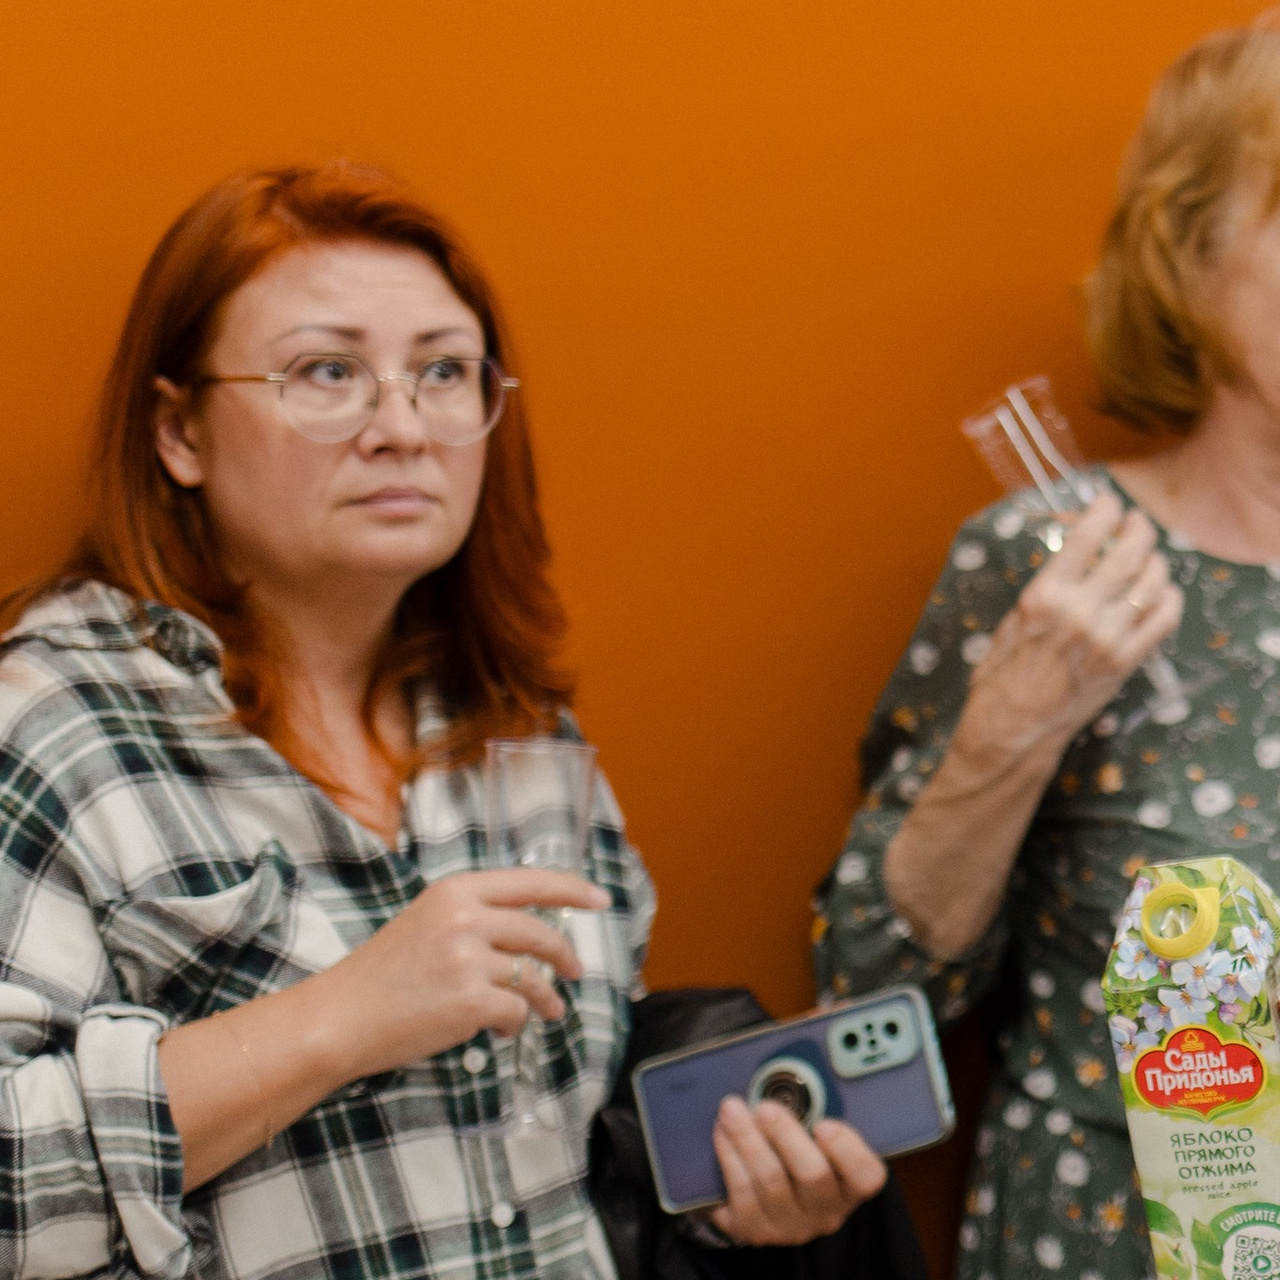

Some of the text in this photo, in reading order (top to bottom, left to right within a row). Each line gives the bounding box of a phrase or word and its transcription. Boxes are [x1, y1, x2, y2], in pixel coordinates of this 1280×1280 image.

[1164, 1049, 1227, 1072] Сады
[1144, 1066, 1255, 1095] Придонья
[1170, 1127, 1253, 1148] ЯБЛОКО
[1174, 1145, 1255, 1163] ПРЯМОГО
[1178, 1161, 1257, 1179] ОТЖИМА
[1182, 1180, 1258, 1194] pressed apple
[1220, 1209, 1276, 1232] СМОТРИТЕ
